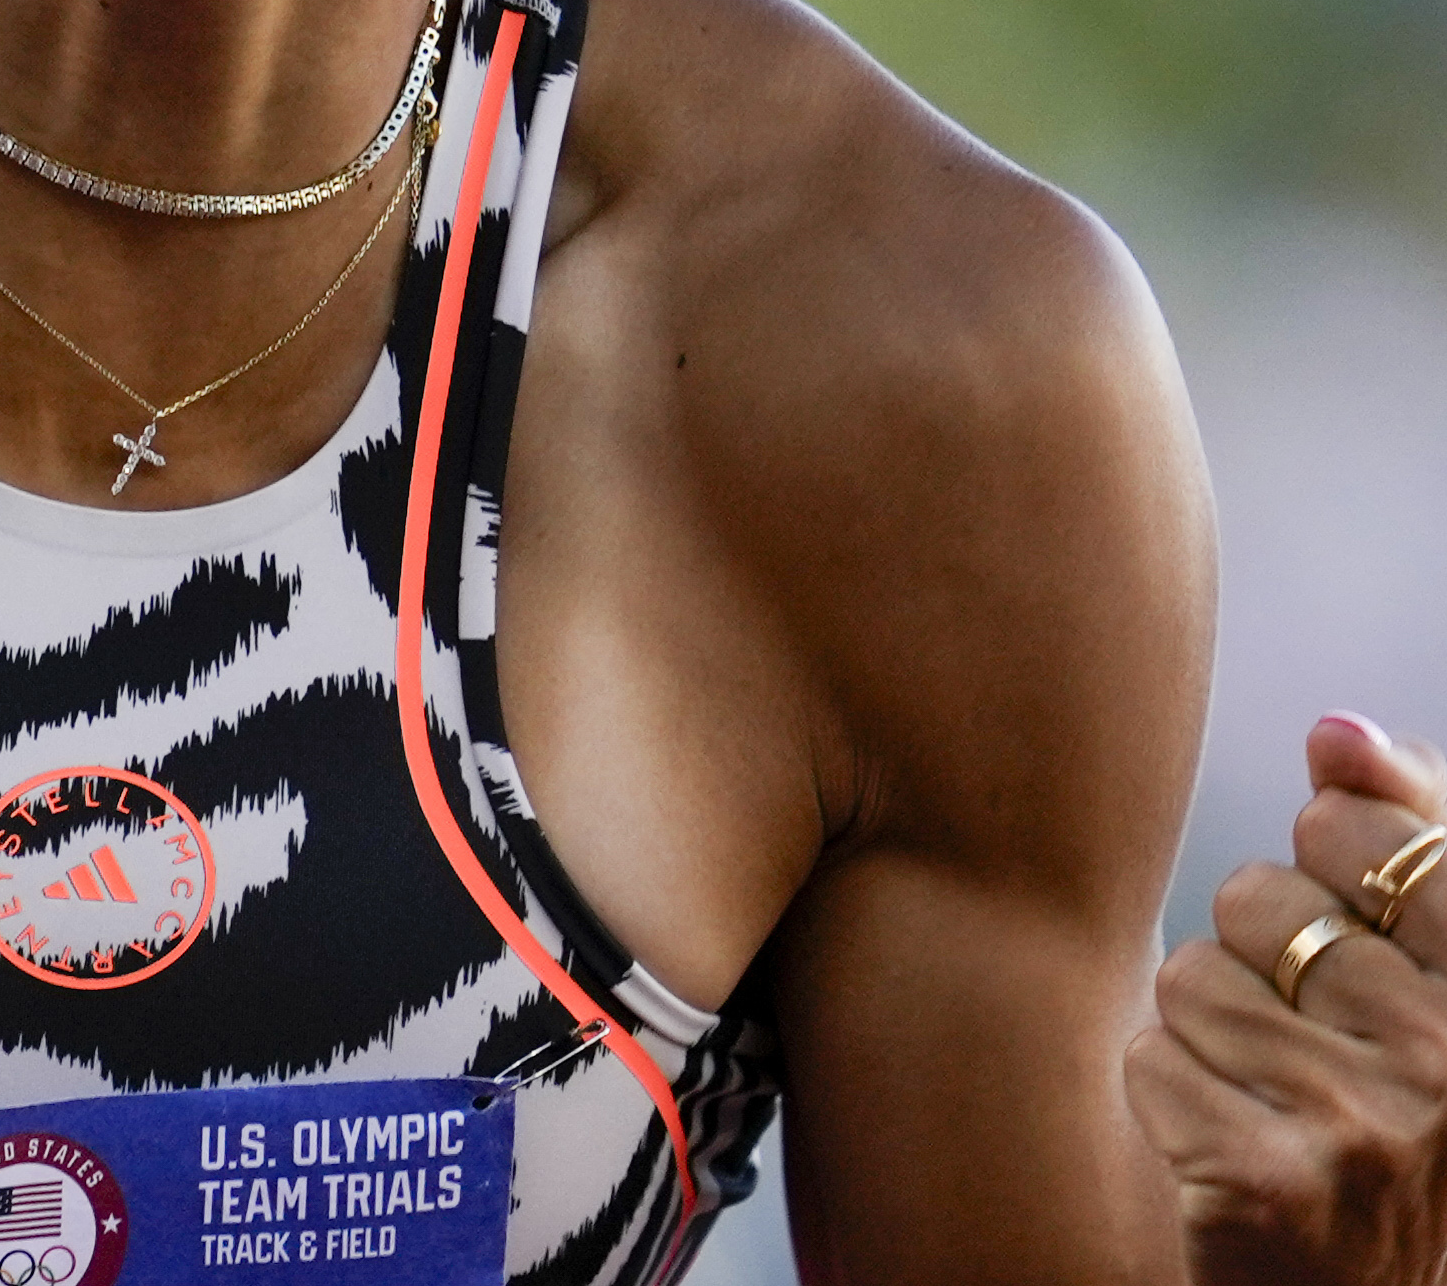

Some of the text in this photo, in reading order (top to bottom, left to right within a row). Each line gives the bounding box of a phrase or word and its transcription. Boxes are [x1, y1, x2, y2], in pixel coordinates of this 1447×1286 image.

[27, 1137, 104, 1189] STATES
[201, 1109, 465, 1171] U.S. OLYMPIC
[198, 1163, 463, 1225] TEAM TRIALS
[200, 1224, 397, 1266] TRACK & FIELD
